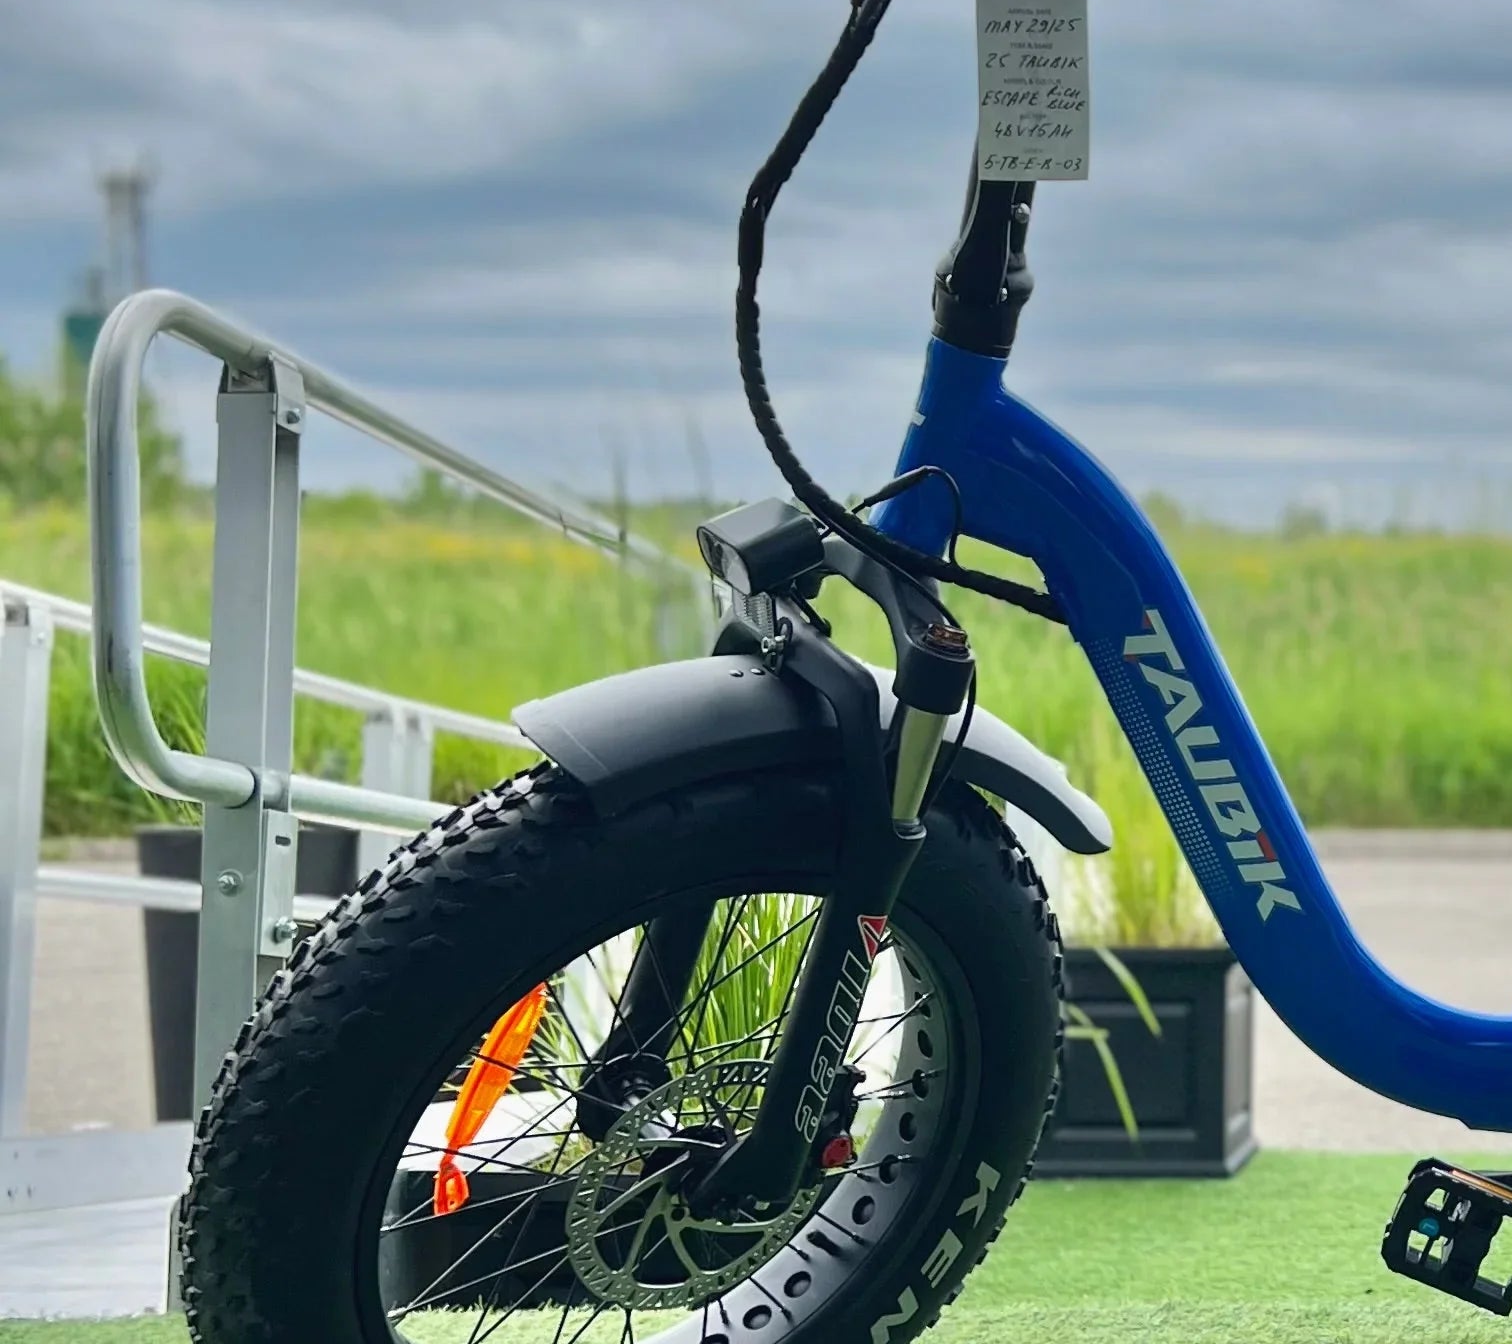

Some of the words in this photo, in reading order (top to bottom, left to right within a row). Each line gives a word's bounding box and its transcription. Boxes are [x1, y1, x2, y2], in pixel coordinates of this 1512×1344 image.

[984, 19, 1024, 33] MAY
[1025, 18, 1082, 34] 29/25
[985, 52, 1010, 68] 25
[1018, 54, 1083, 69] TAUBIK
[981, 89, 1039, 107] ESCAPE
[1046, 98, 1086, 111] BLUE
[1123, 608, 1303, 922] TAUBIK
